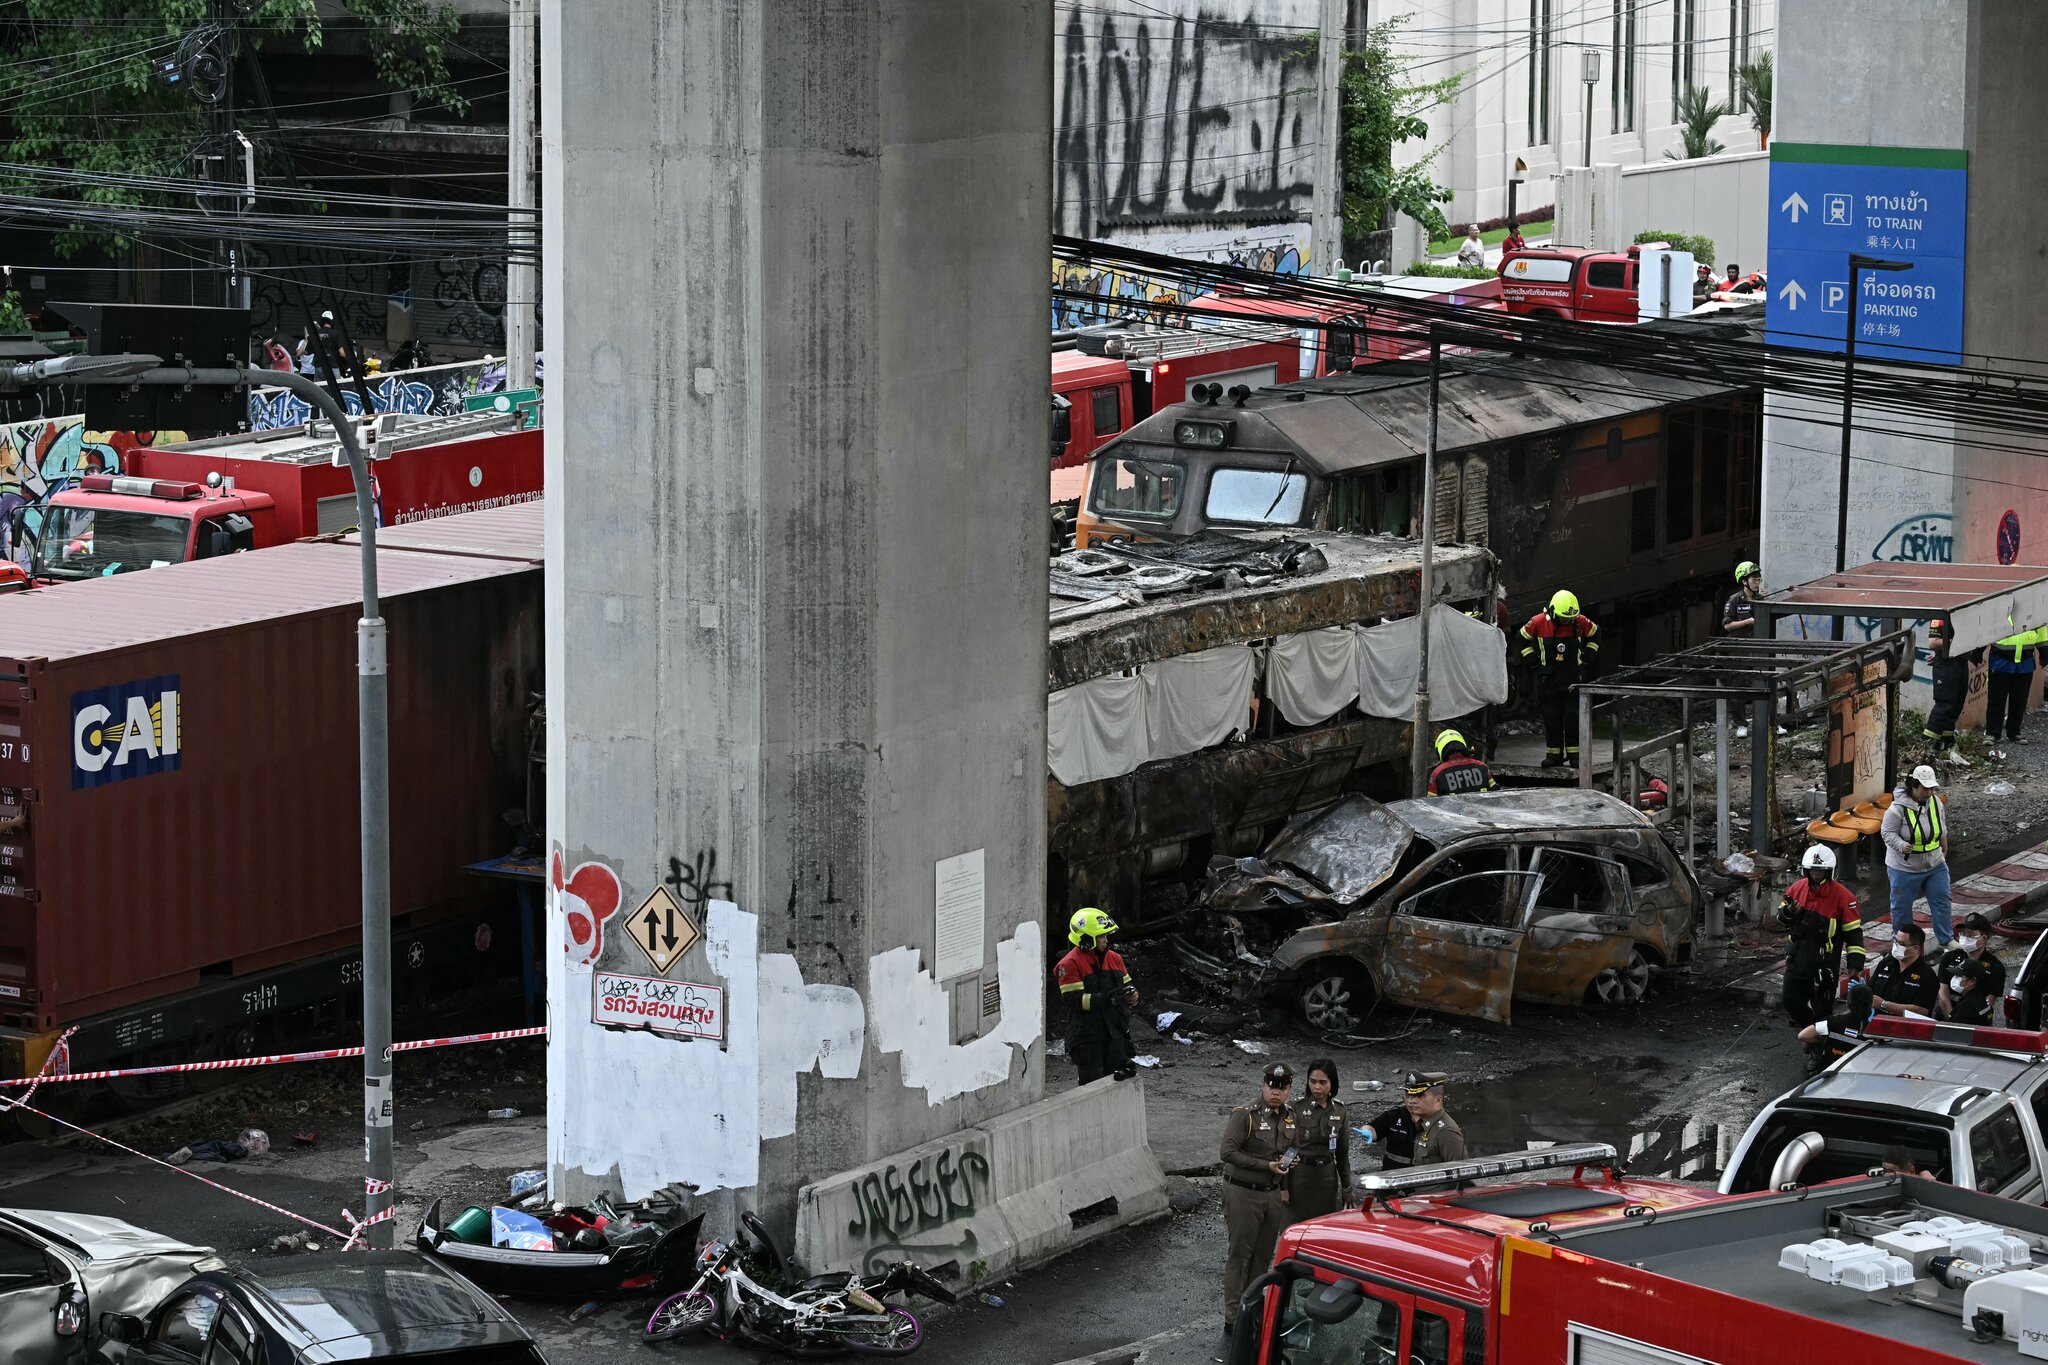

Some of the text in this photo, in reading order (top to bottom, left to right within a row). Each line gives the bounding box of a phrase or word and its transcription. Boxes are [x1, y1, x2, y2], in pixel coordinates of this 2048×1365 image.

[1865, 190, 1928, 212] ทางเข้า
[1866, 216, 1922, 231] TO TRAIN
[1863, 271, 1936, 300] ที่จอดรถ
[1828, 286, 1844, 308] P
[1864, 303, 1918, 318] PARKING
[1862, 322, 1901, 337] 停车场
[74, 690, 178, 772] CAI
[1445, 767, 1484, 791] BFRD
[3, 795, 15, 805] LBS
[2, 846, 15, 855] KGS
[1, 856, 12, 866] LBS
[603, 987, 715, 1024] รถวิ่งสวนทาง
